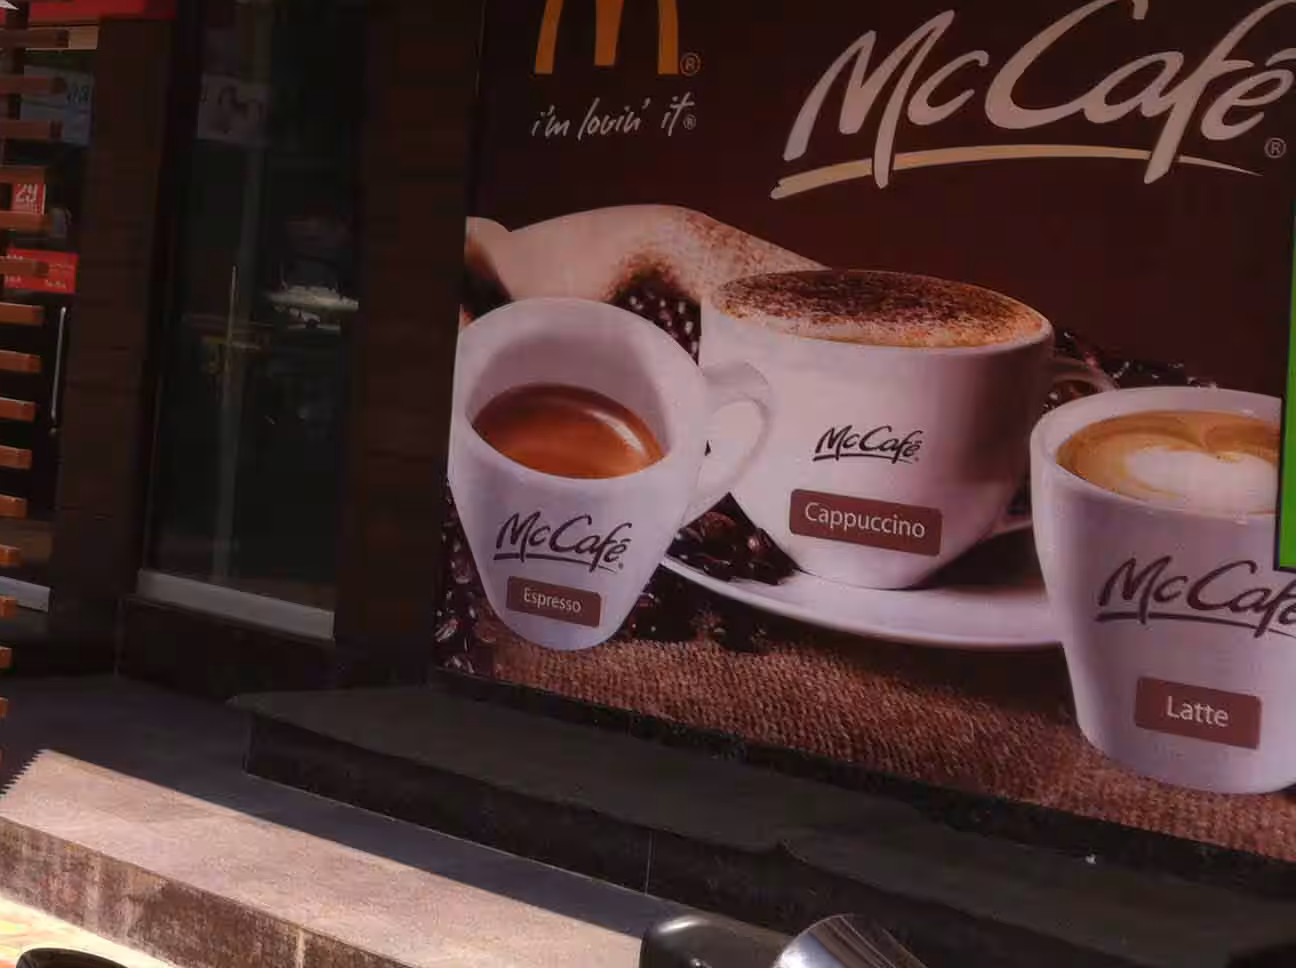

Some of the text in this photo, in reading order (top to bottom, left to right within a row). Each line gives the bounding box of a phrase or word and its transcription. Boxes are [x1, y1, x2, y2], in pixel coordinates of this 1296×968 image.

[531, 104, 571, 138] i'm
[577, 97, 651, 141] lovin'
[814, 425, 924, 464] McCafé
[805, 502, 926, 539] Cappuccino
[495, 511, 632, 573] McCafé
[523, 587, 582, 613] Espresso
[1166, 695, 1229, 728] Latte
